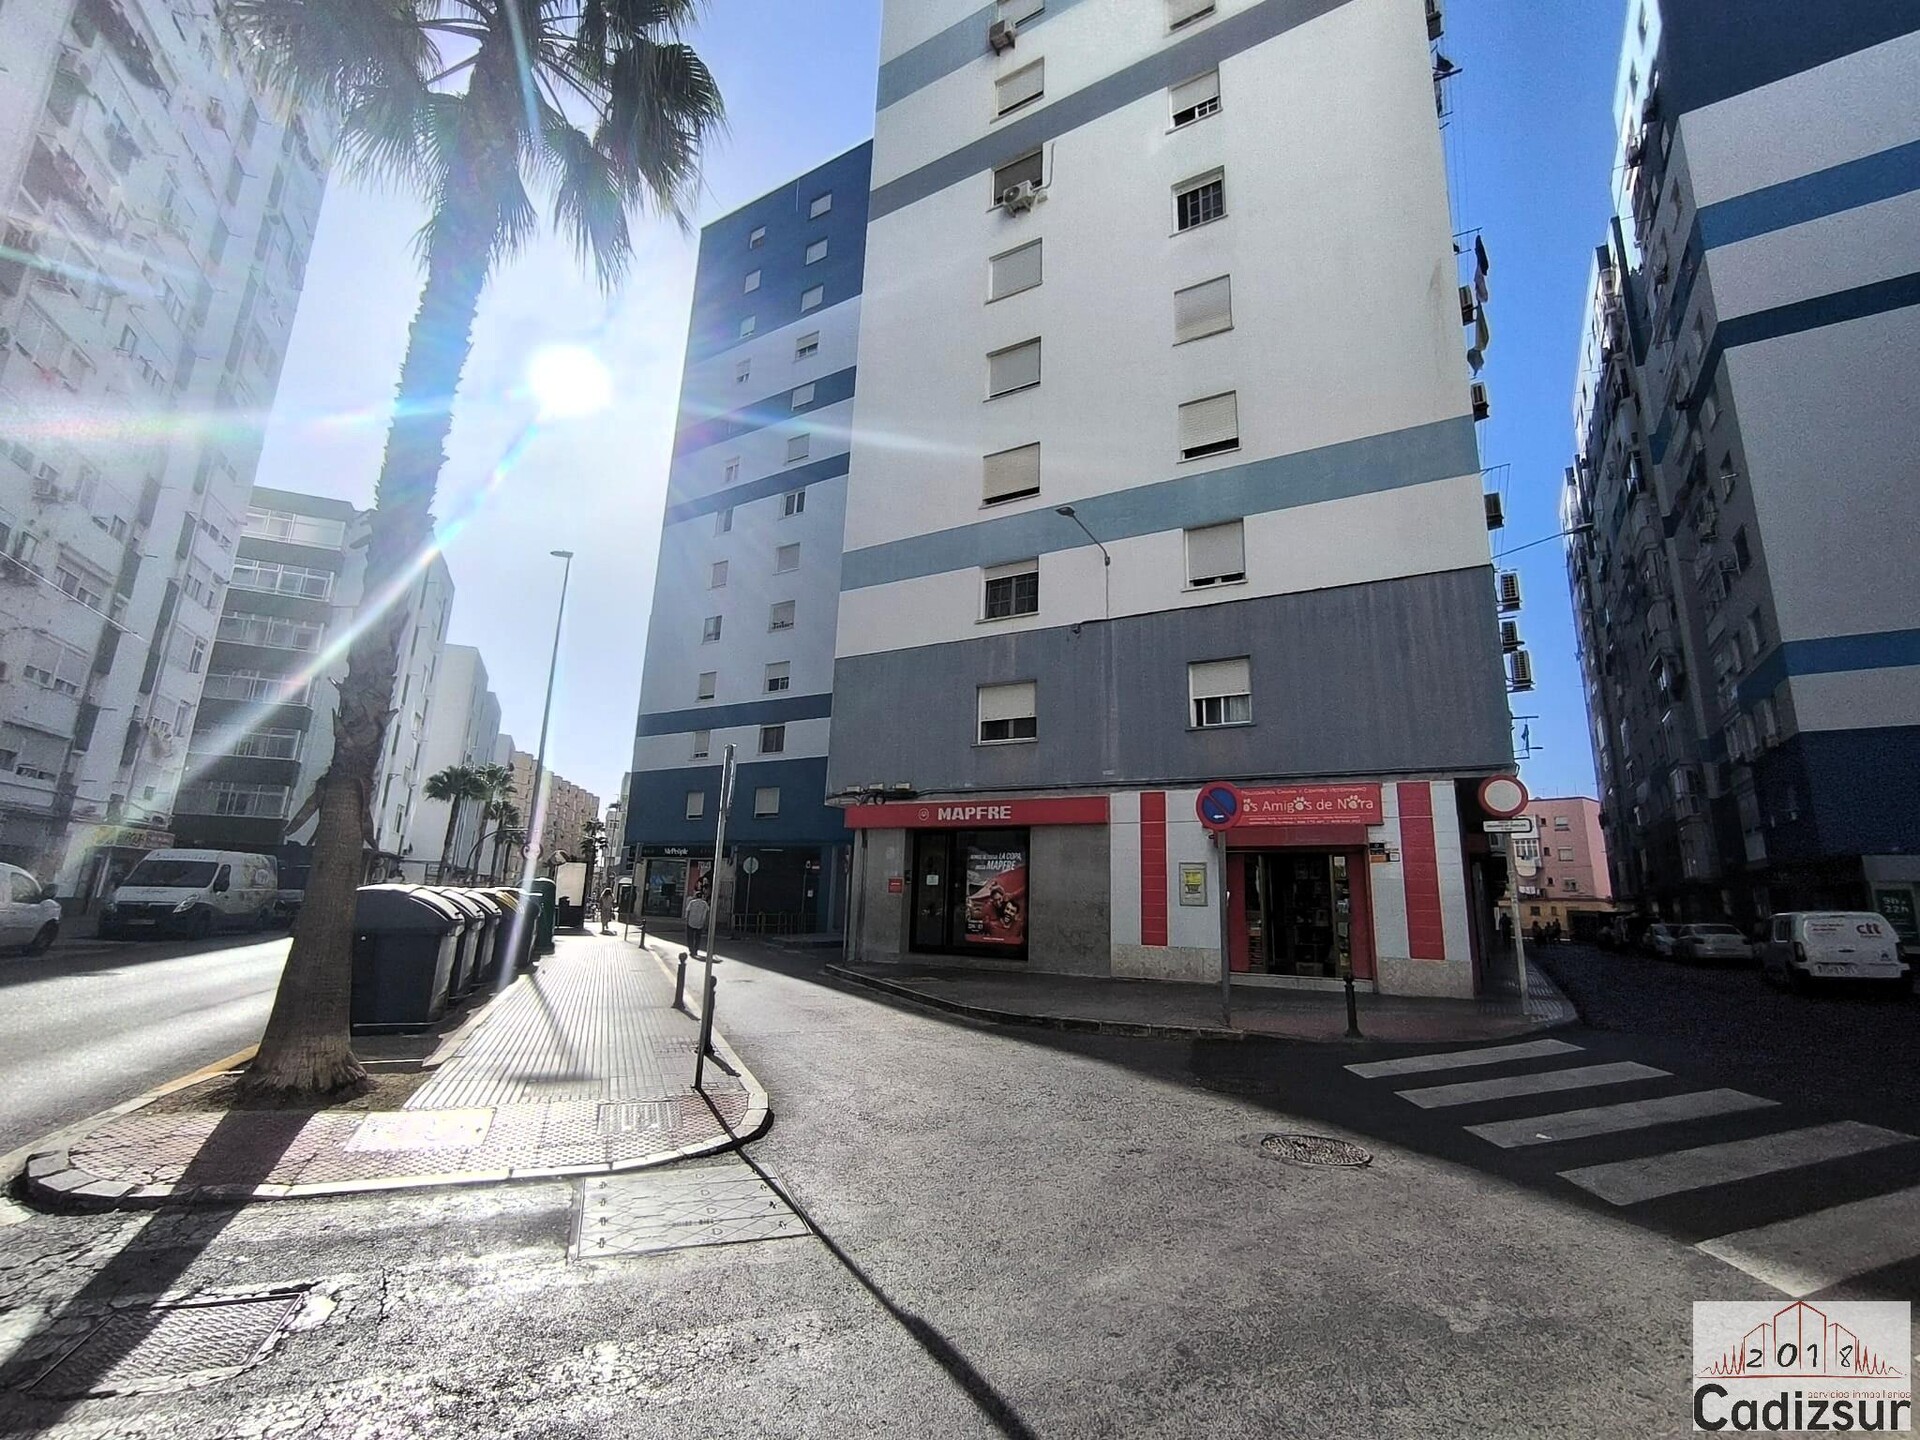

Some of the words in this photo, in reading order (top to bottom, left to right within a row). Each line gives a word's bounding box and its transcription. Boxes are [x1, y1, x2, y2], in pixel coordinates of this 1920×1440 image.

[1262, 796, 1312, 814] Amigos
[1316, 797, 1333, 810] de
[1337, 794, 1373, 810] Nora
[938, 806, 1012, 821] MAPFRE
[986, 860, 1016, 870] MAPFRE
[1856, 922, 1882, 935] ctt
